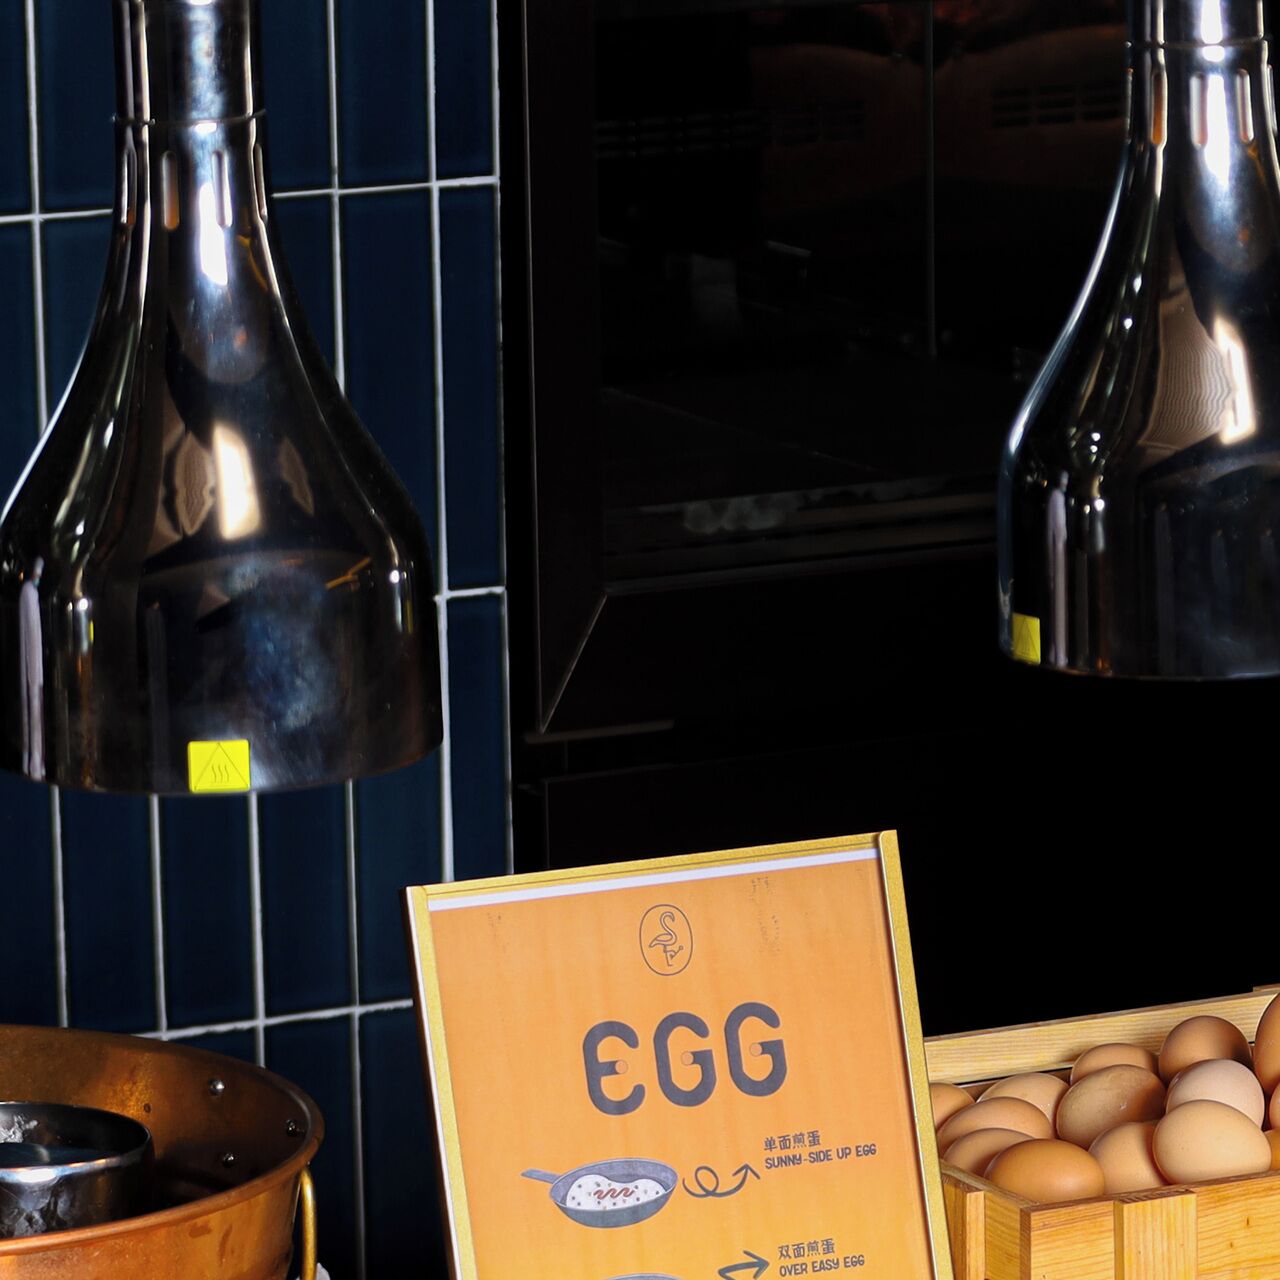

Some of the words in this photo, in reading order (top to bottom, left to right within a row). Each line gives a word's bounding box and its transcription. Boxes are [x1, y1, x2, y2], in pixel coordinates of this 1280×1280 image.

[582, 1001, 788, 1116] EGG
[763, 1130, 821, 1152] 单面煎蛋
[764, 1149, 833, 1170] SUNNY-SIDE
[836, 1146, 852, 1160] UP
[855, 1143, 877, 1157] EGG
[778, 1238, 835, 1260] 双面煎蛋
[779, 1262, 808, 1277] OVER
[812, 1258, 840, 1273] EASY
[843, 1254, 865, 1268] EGG
